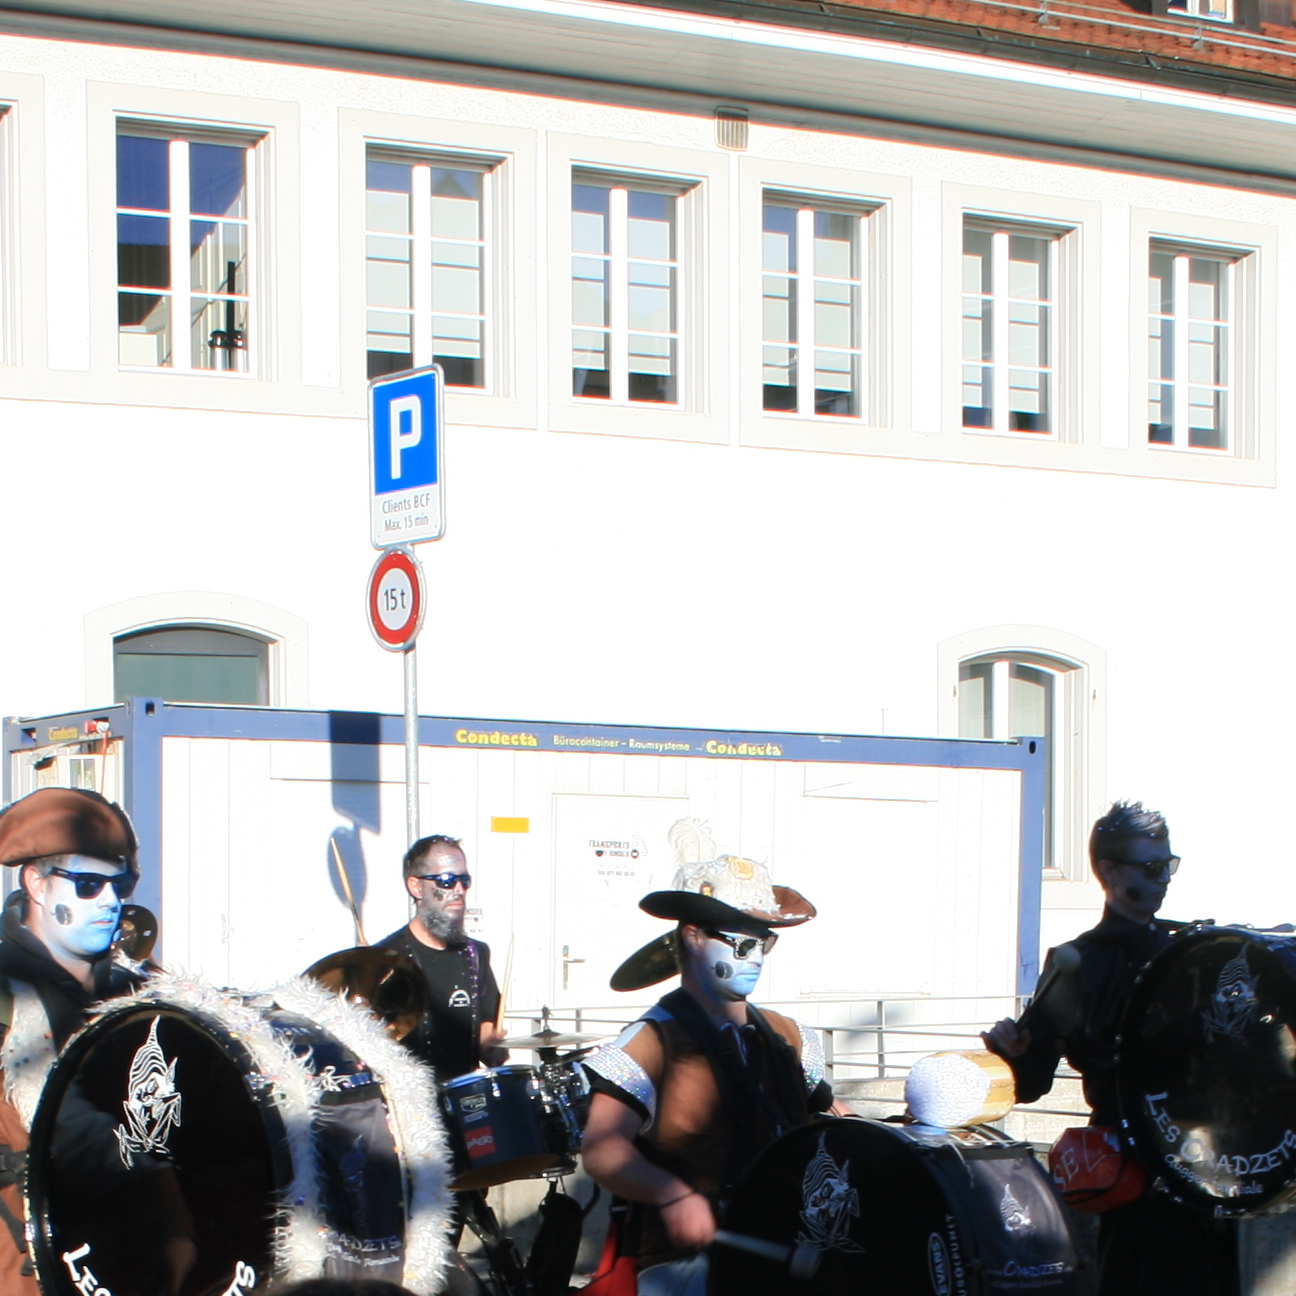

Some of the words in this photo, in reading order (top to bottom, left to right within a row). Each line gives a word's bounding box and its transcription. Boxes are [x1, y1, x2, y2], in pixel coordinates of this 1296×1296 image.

[390, 395, 422, 480] P
[382, 498, 411, 514] Clients
[414, 492, 430, 509] BCF
[404, 514, 413, 529] 15
[415, 512, 429, 527] min
[455, 728, 538, 747] Condecta
[552, 734, 619, 749] Bürocontainer
[628, 737, 691, 753] Raumsysteme
[706, 739, 783, 757] Condecta
[1145, 1091, 1180, 1143] LES
[931, 1242, 948, 1294] EVANS
